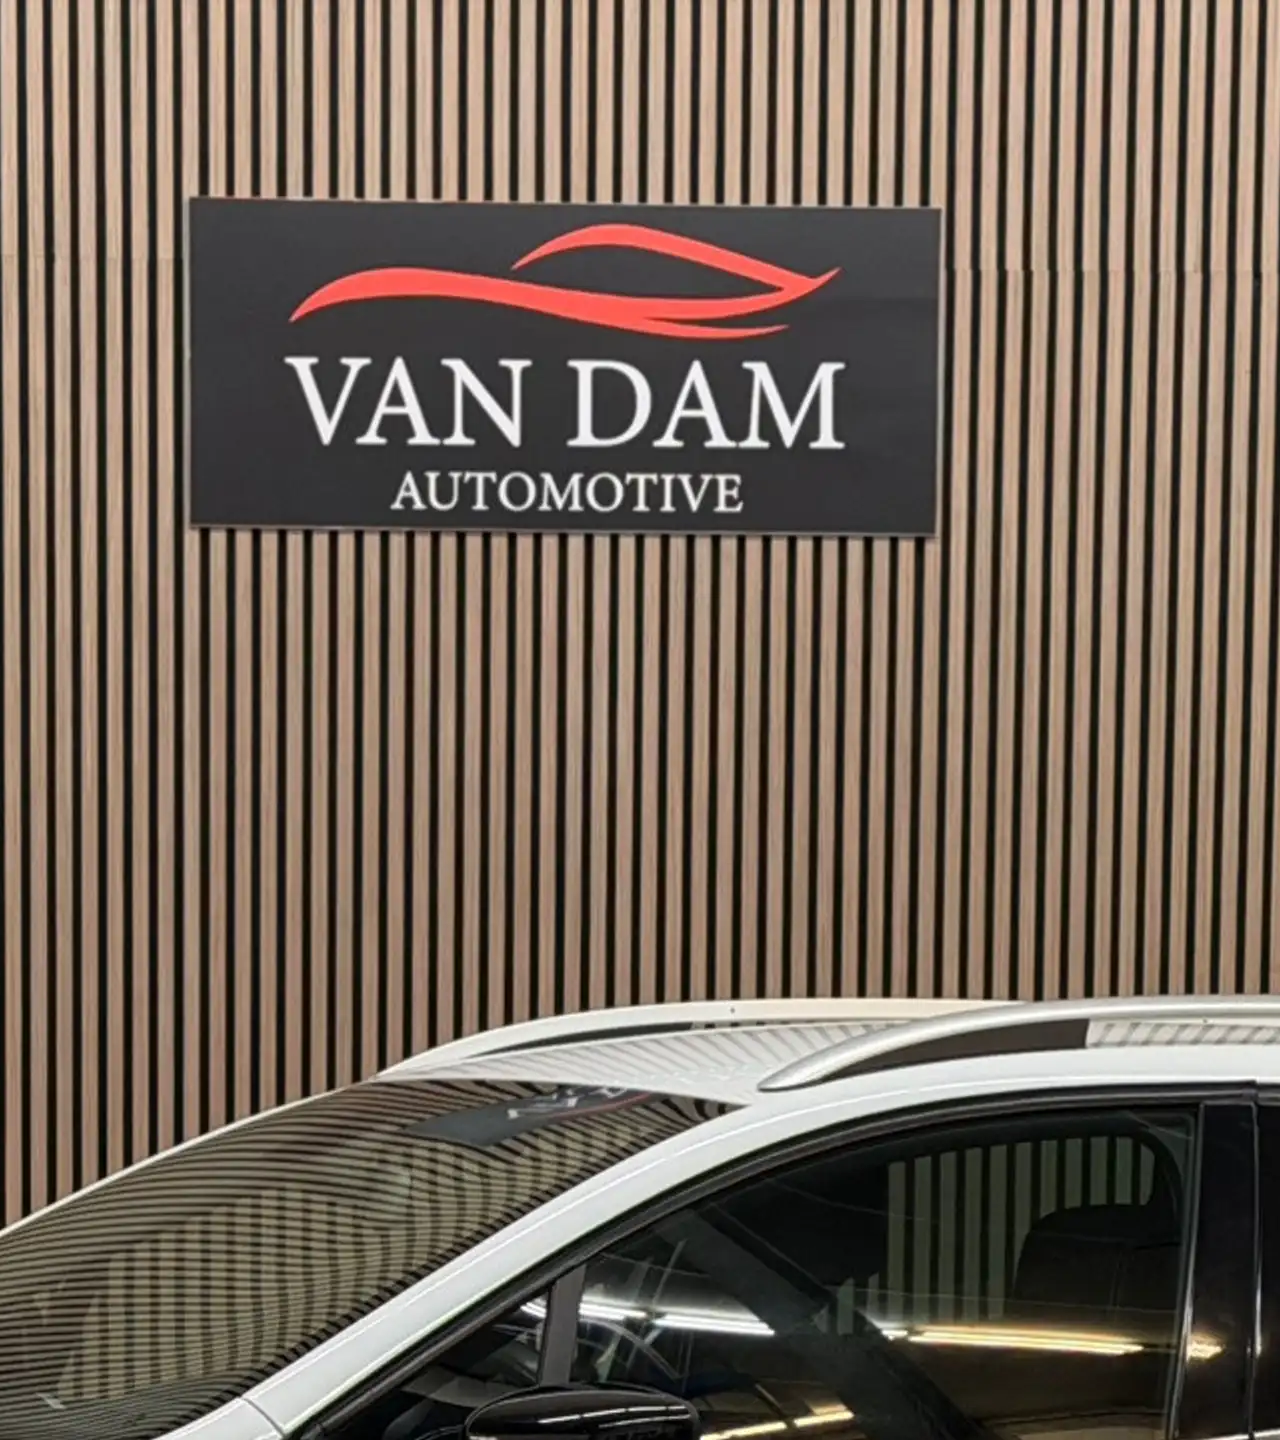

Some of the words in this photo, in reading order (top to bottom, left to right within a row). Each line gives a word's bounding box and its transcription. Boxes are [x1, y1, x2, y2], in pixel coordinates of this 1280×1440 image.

[285, 357, 531, 446] VAN
[568, 360, 844, 448] DAM
[391, 472, 743, 512] AUTOMOTIVE
